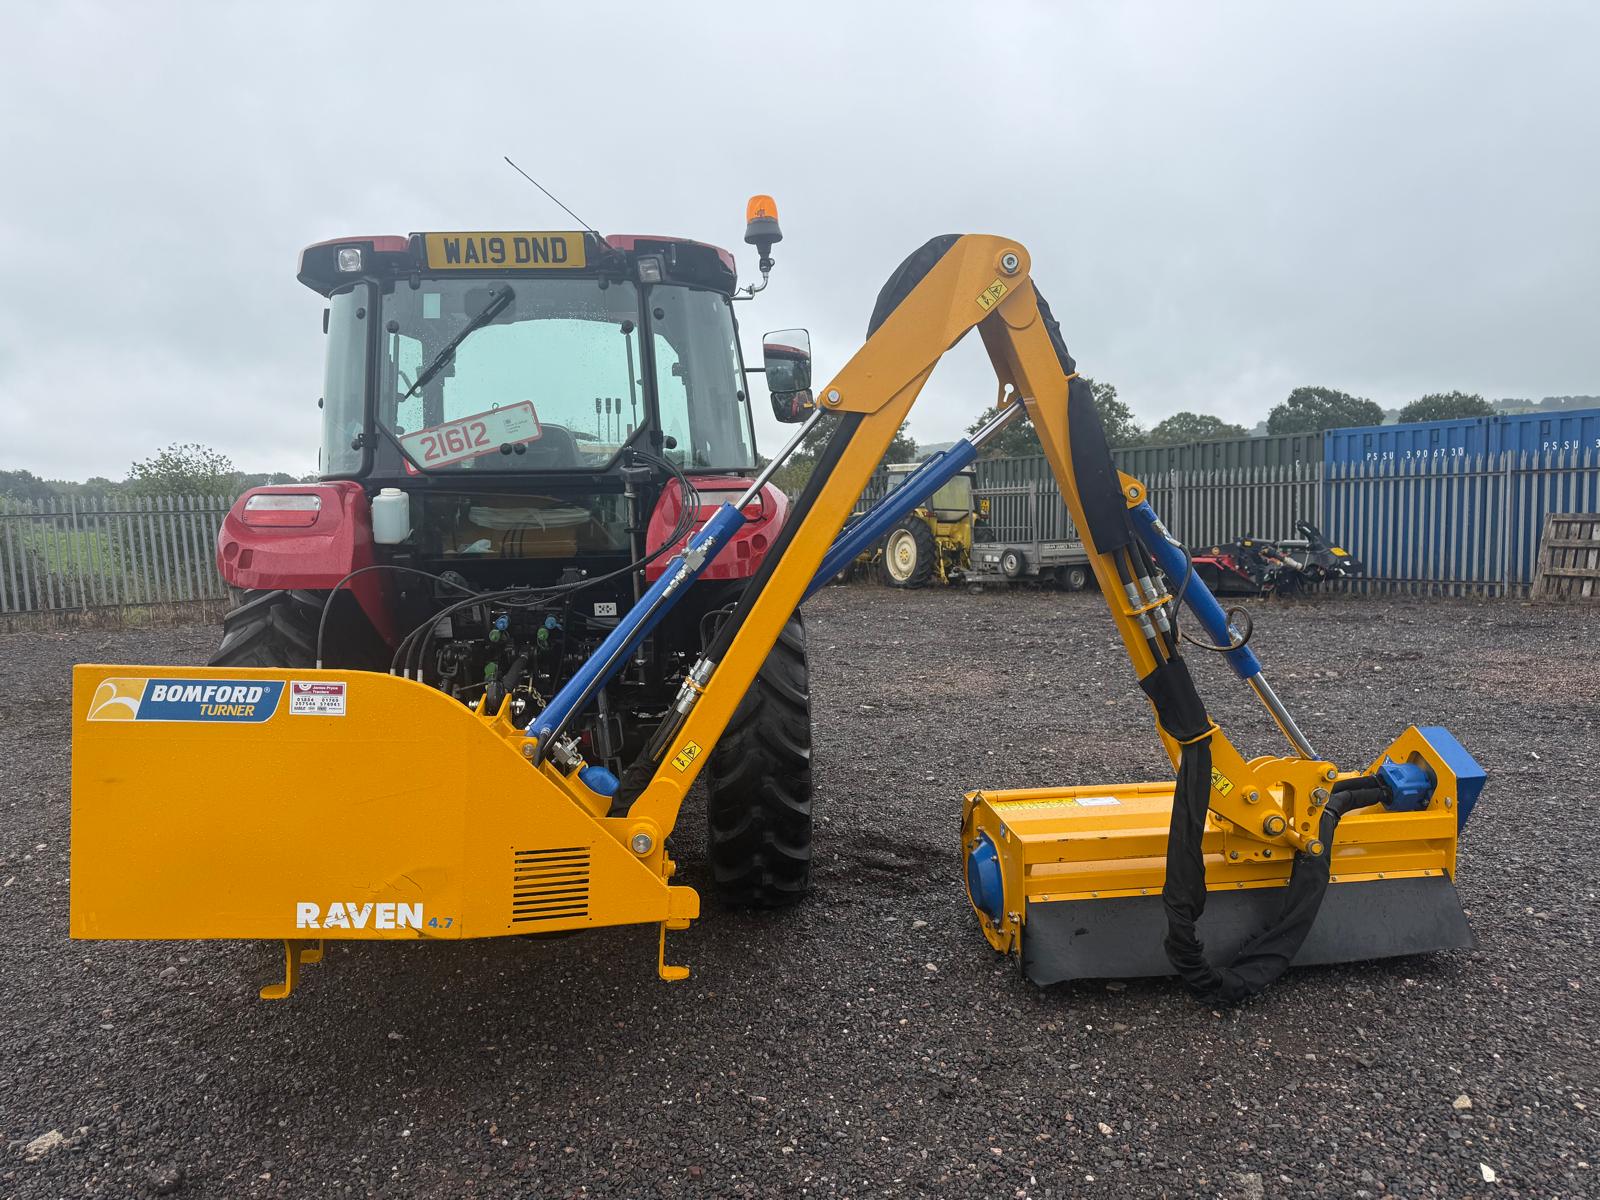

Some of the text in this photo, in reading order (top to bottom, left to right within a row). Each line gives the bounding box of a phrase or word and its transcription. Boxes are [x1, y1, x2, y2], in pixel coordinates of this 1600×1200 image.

[443, 237, 567, 264] WA19 DND
[420, 421, 490, 461] 21612
[1543, 439, 1579, 451] PSSU
[1366, 451, 1394, 461] PSSU
[199, 703, 255, 717] TURNER
[296, 902, 454, 929] RAVEN 4.7
